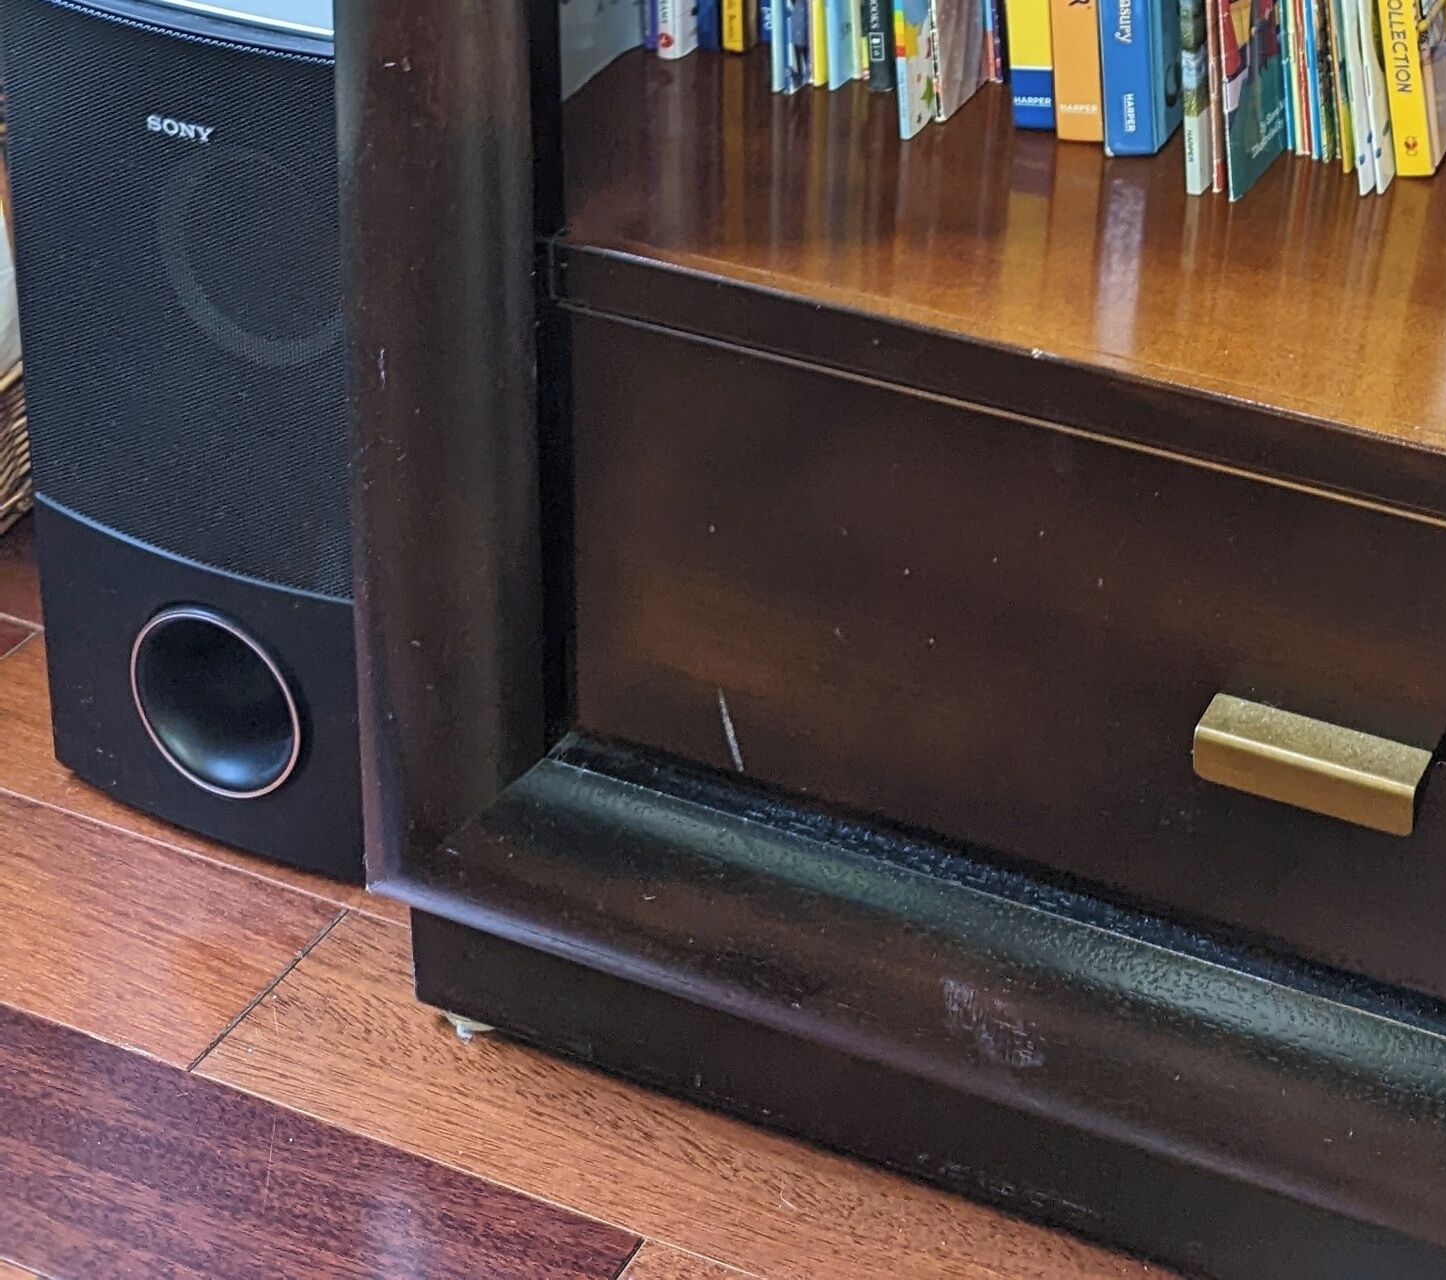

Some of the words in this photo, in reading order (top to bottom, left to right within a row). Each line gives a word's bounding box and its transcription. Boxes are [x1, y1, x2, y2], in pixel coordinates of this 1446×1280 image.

[1013, 95, 1052, 105] HARPER
[1058, 104, 1097, 113] HARPER
[1125, 93, 1137, 132] HARPER
[147, 115, 215, 144] SONY
